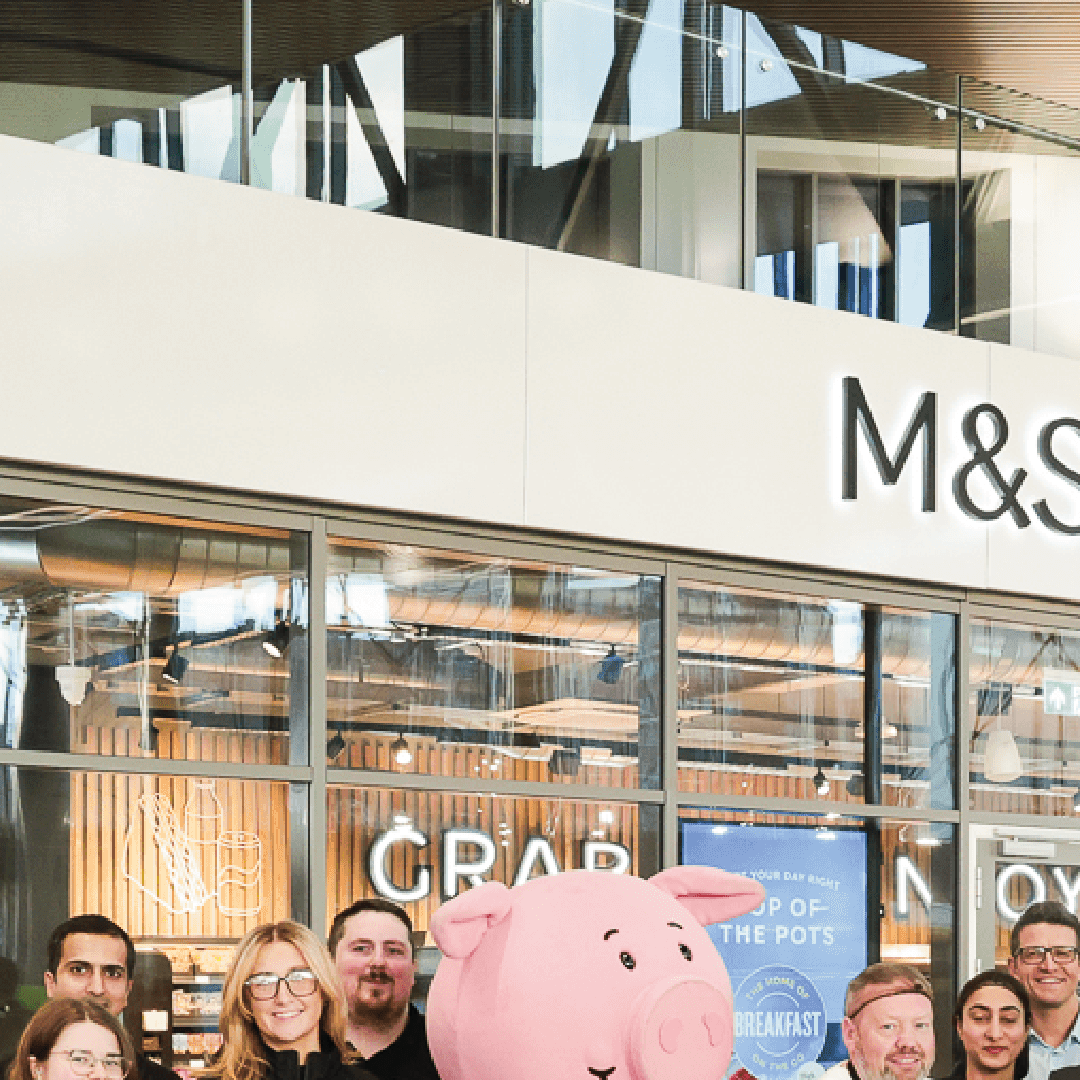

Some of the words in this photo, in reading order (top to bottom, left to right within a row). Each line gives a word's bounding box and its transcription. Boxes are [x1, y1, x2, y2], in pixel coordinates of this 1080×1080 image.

[791, 898, 822, 917] OF
[719, 924, 766, 945] THE
[775, 924, 835, 946] POTS
[734, 1011, 822, 1037] BREAKFAST
